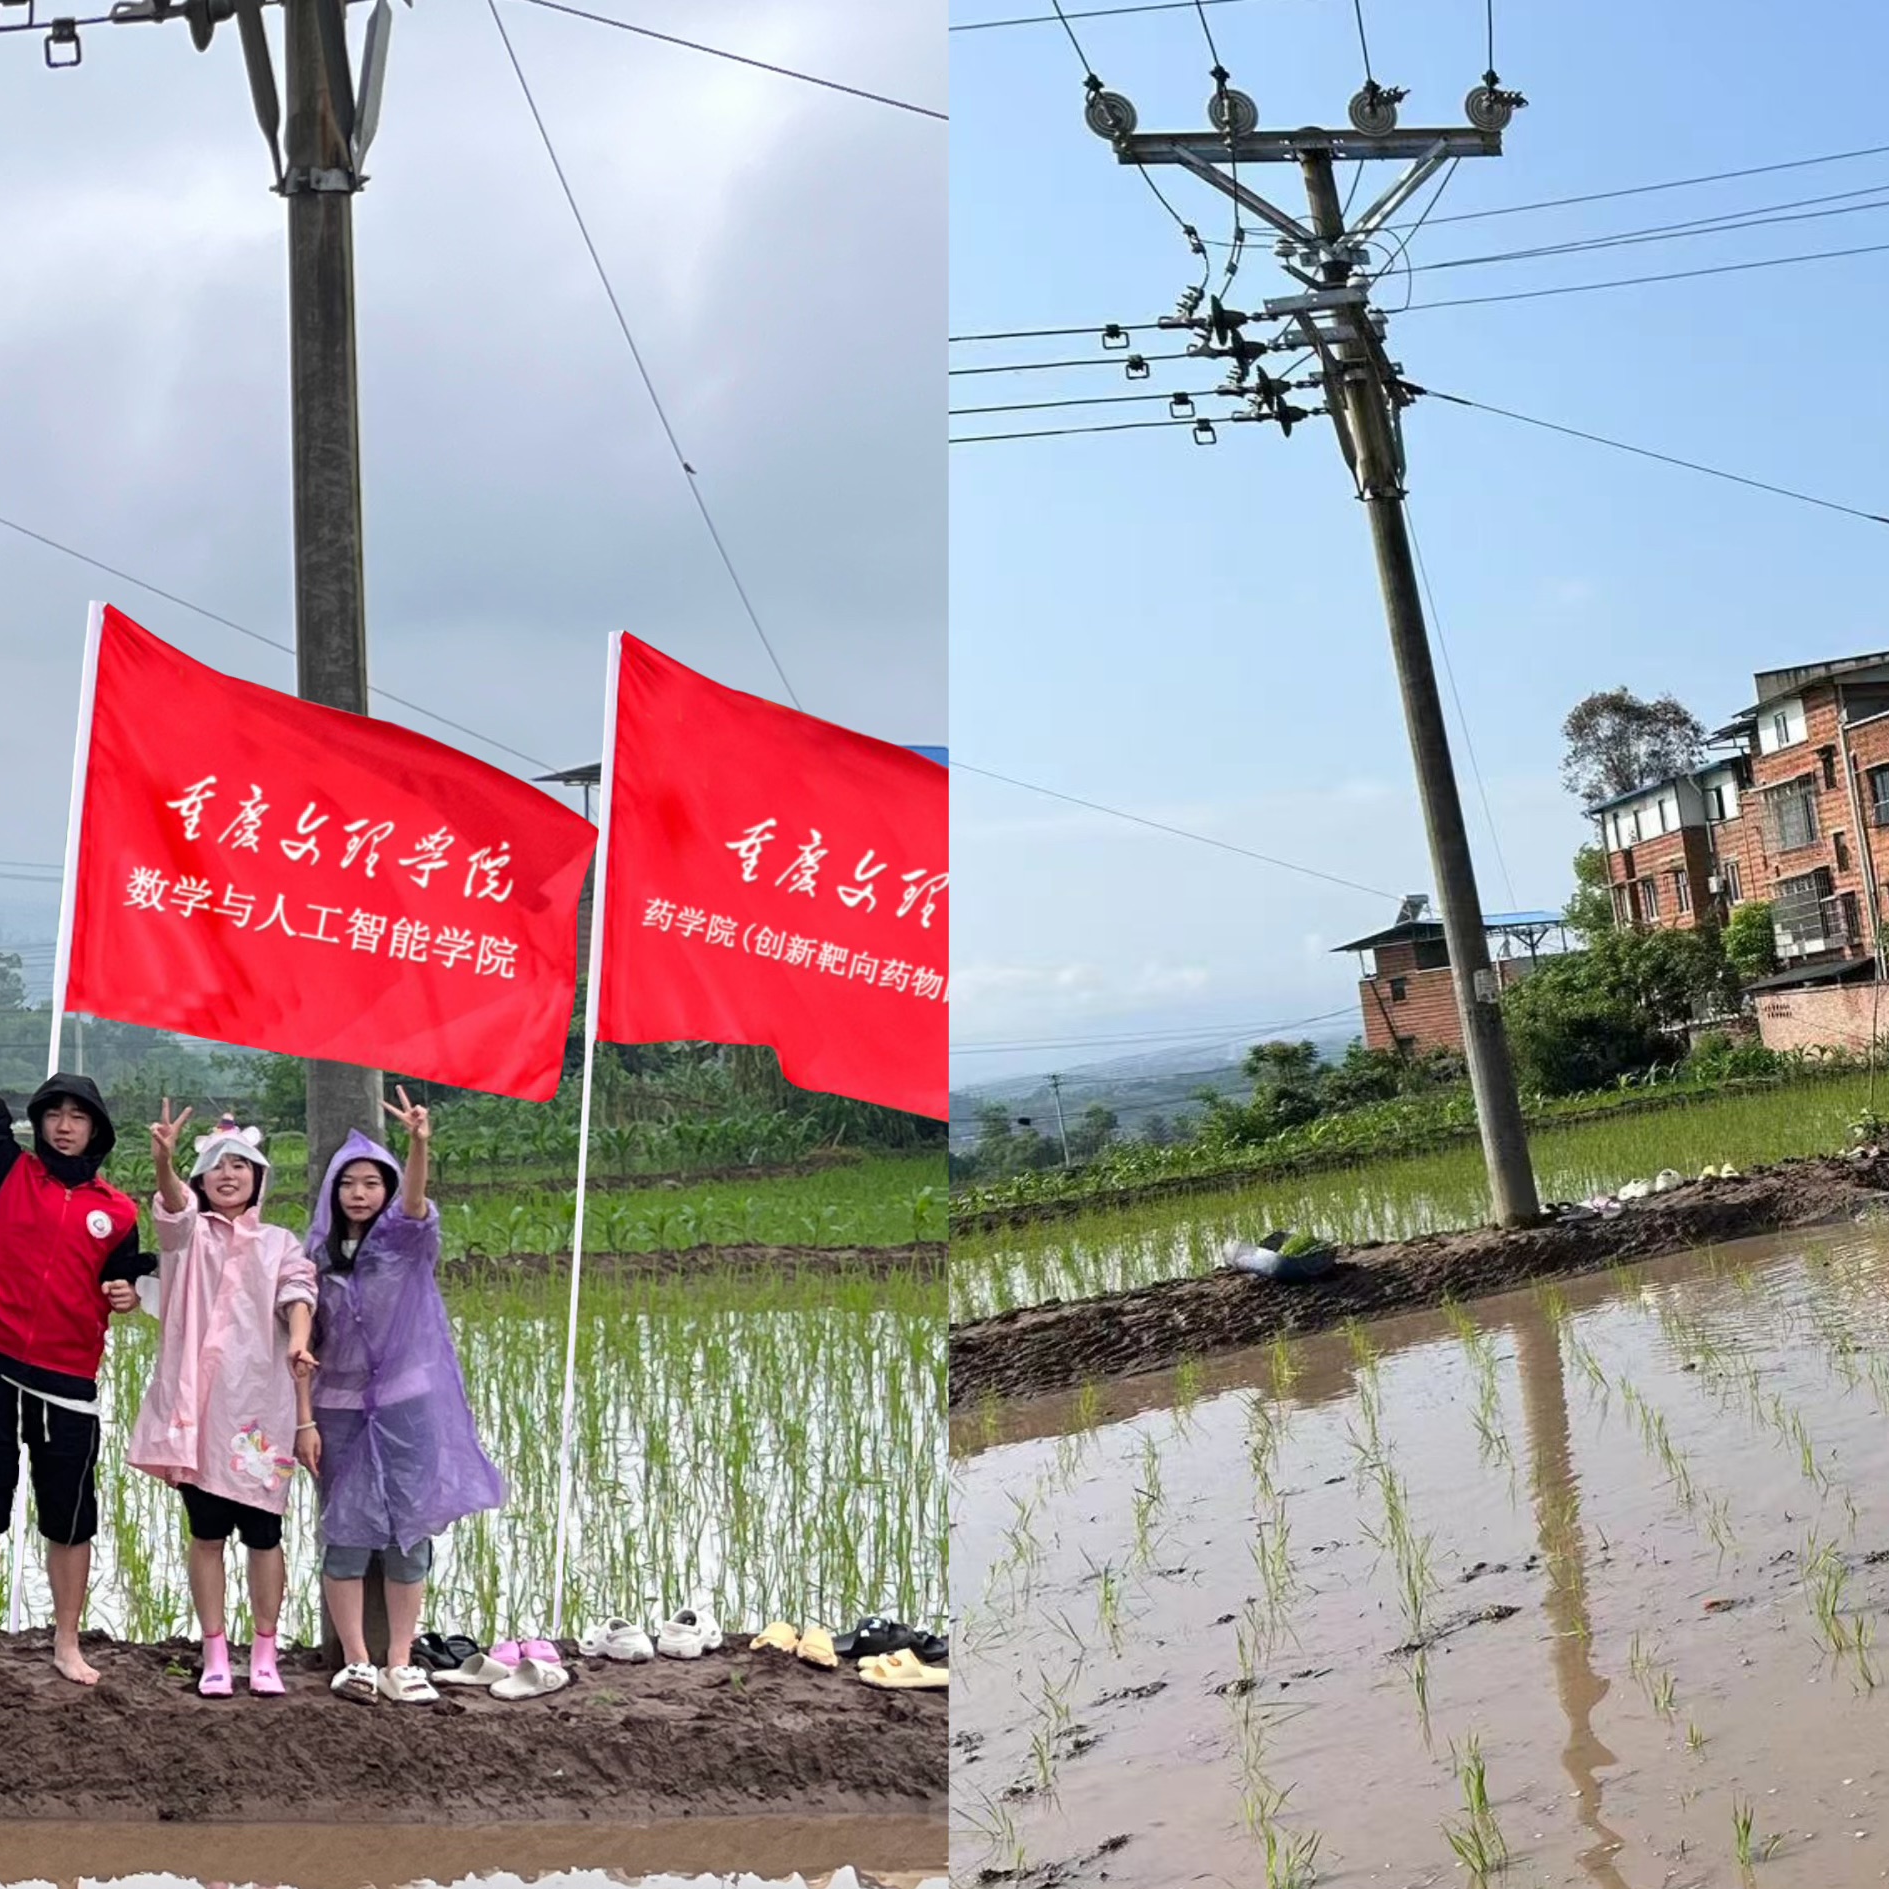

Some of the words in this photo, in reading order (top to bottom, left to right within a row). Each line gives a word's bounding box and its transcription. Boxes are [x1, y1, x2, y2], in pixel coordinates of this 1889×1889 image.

[123, 865, 519, 979] 数学与人工智能学院
[641, 896, 949, 1003] 药学院(创新靶向药物
